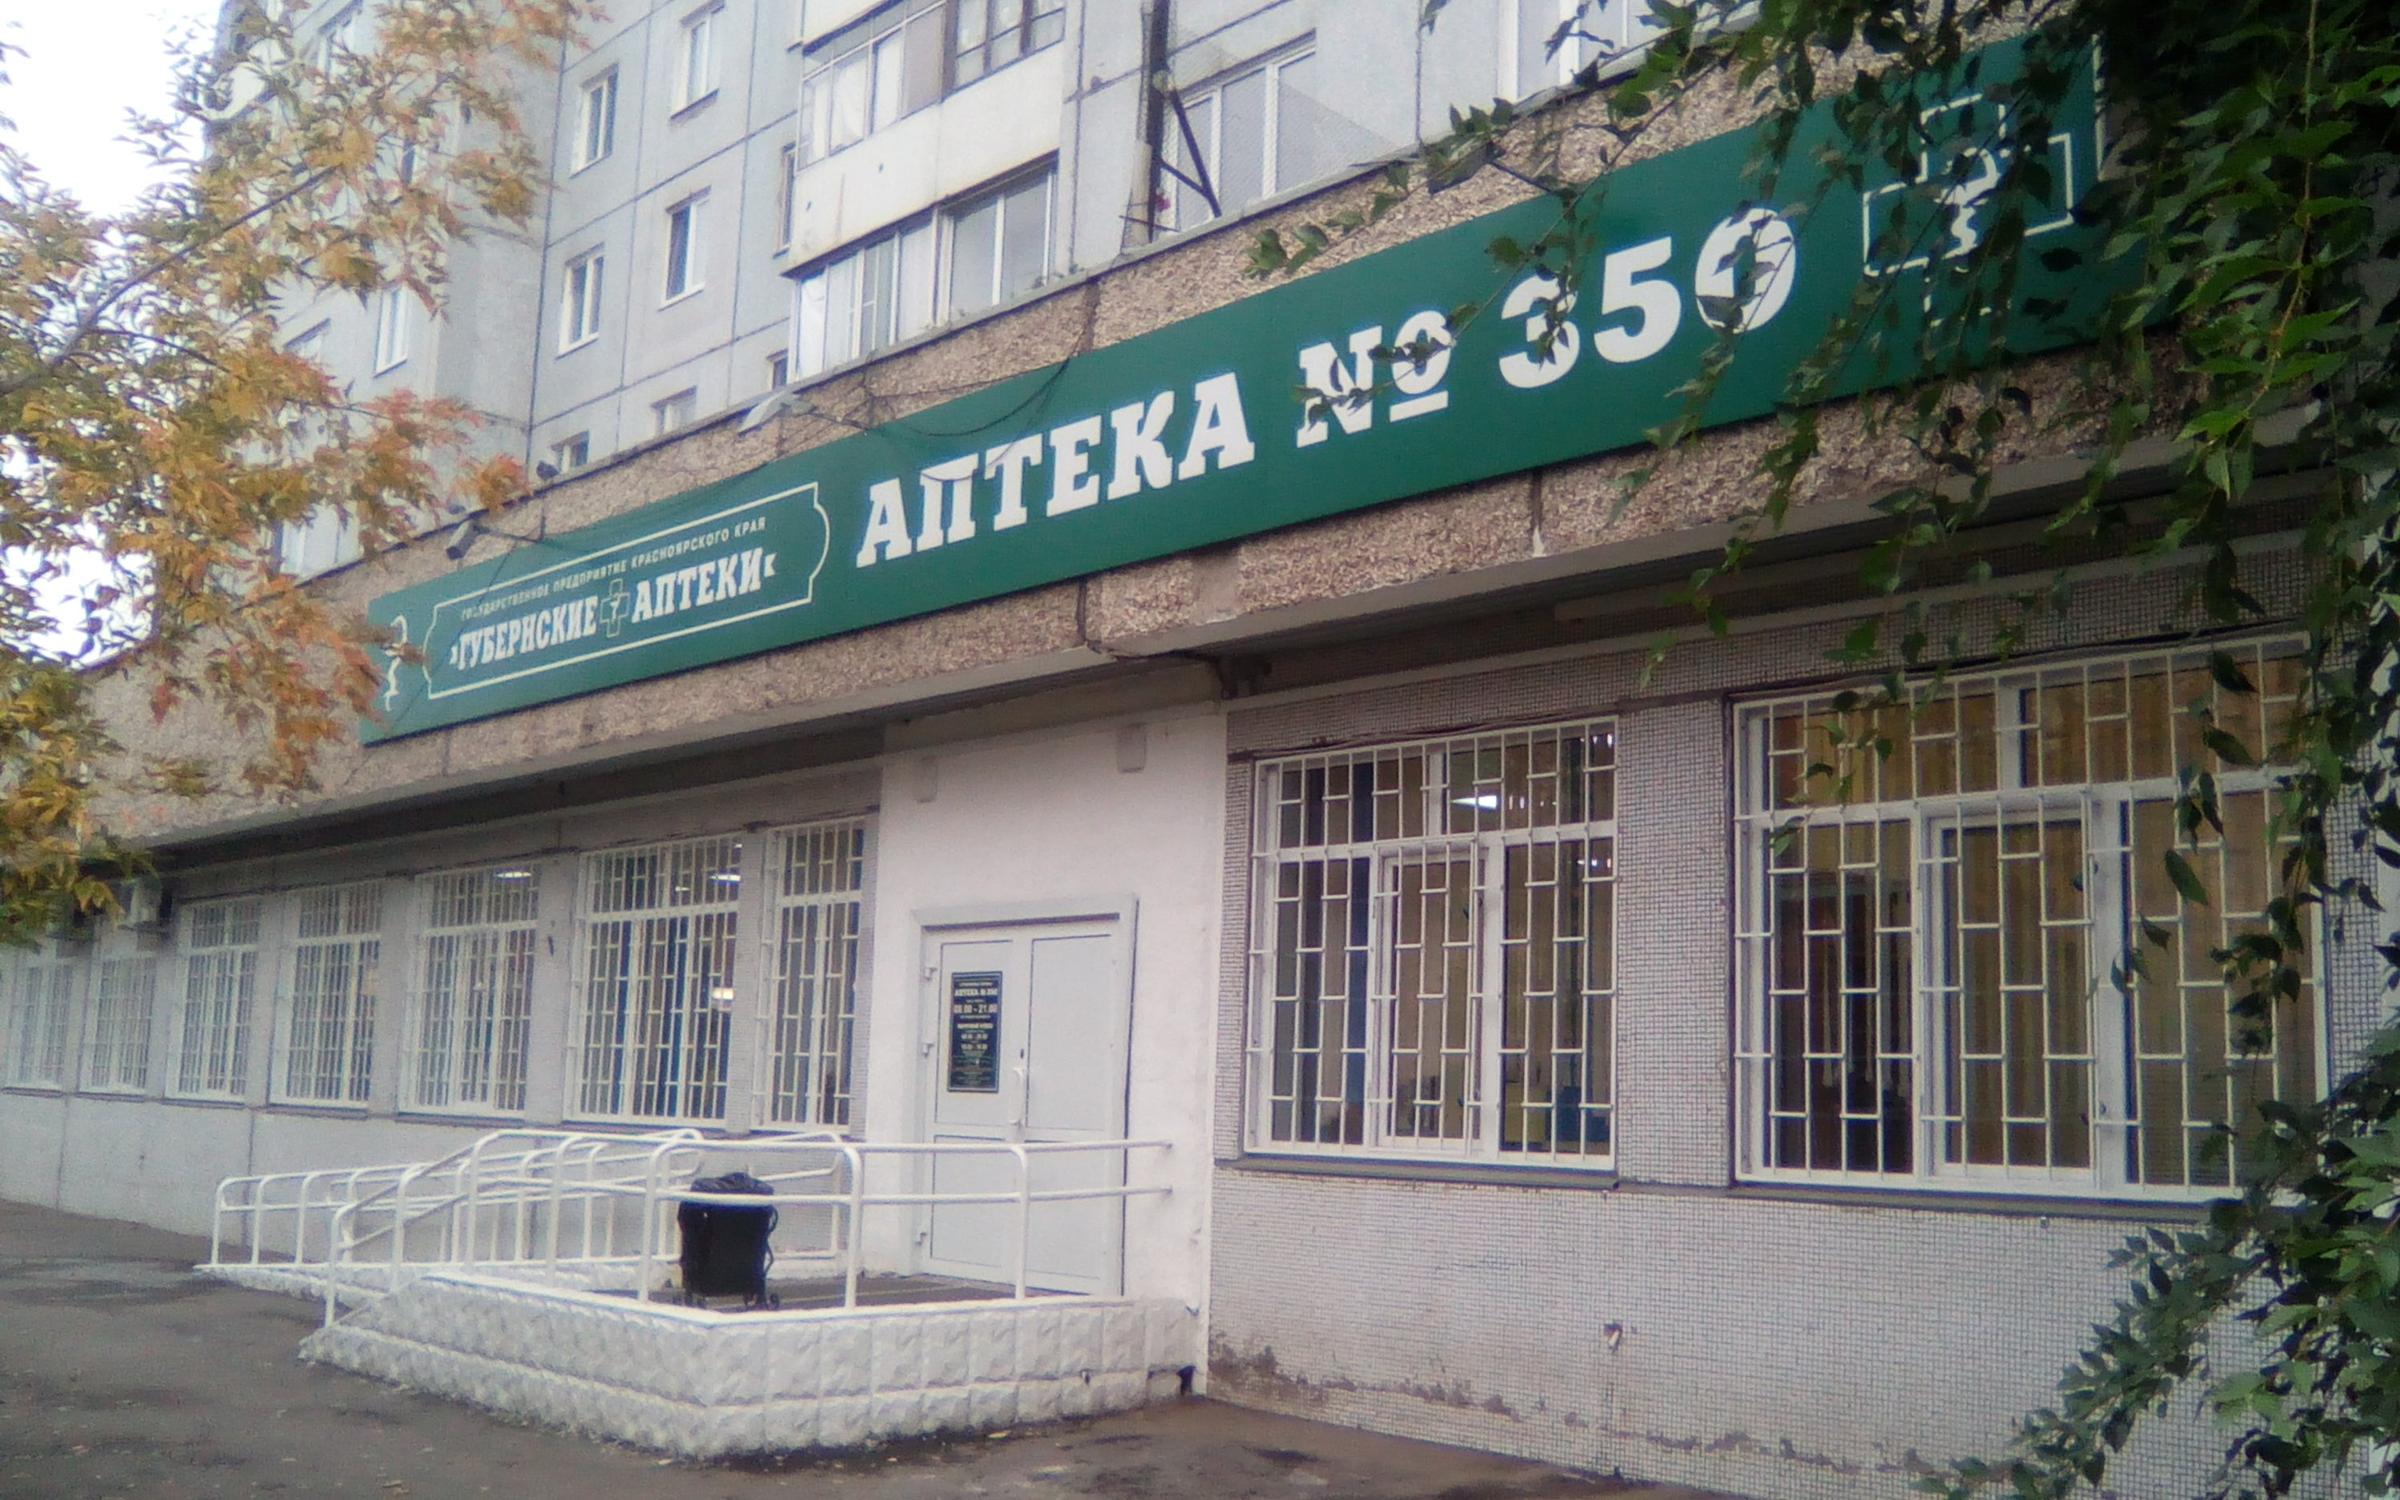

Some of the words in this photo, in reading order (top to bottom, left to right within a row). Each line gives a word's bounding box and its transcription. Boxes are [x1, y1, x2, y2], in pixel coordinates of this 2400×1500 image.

[856, 371, 1255, 568] АПТЕКА
[1296, 310, 1453, 448] №
[1499, 208, 1796, 389] 350
[553, 559, 627, 593] ПРЕДПРИЯТИЕ
[631, 528, 730, 569] КРАСНОЯРСКОГО
[734, 516, 767, 539] КРАЯ
